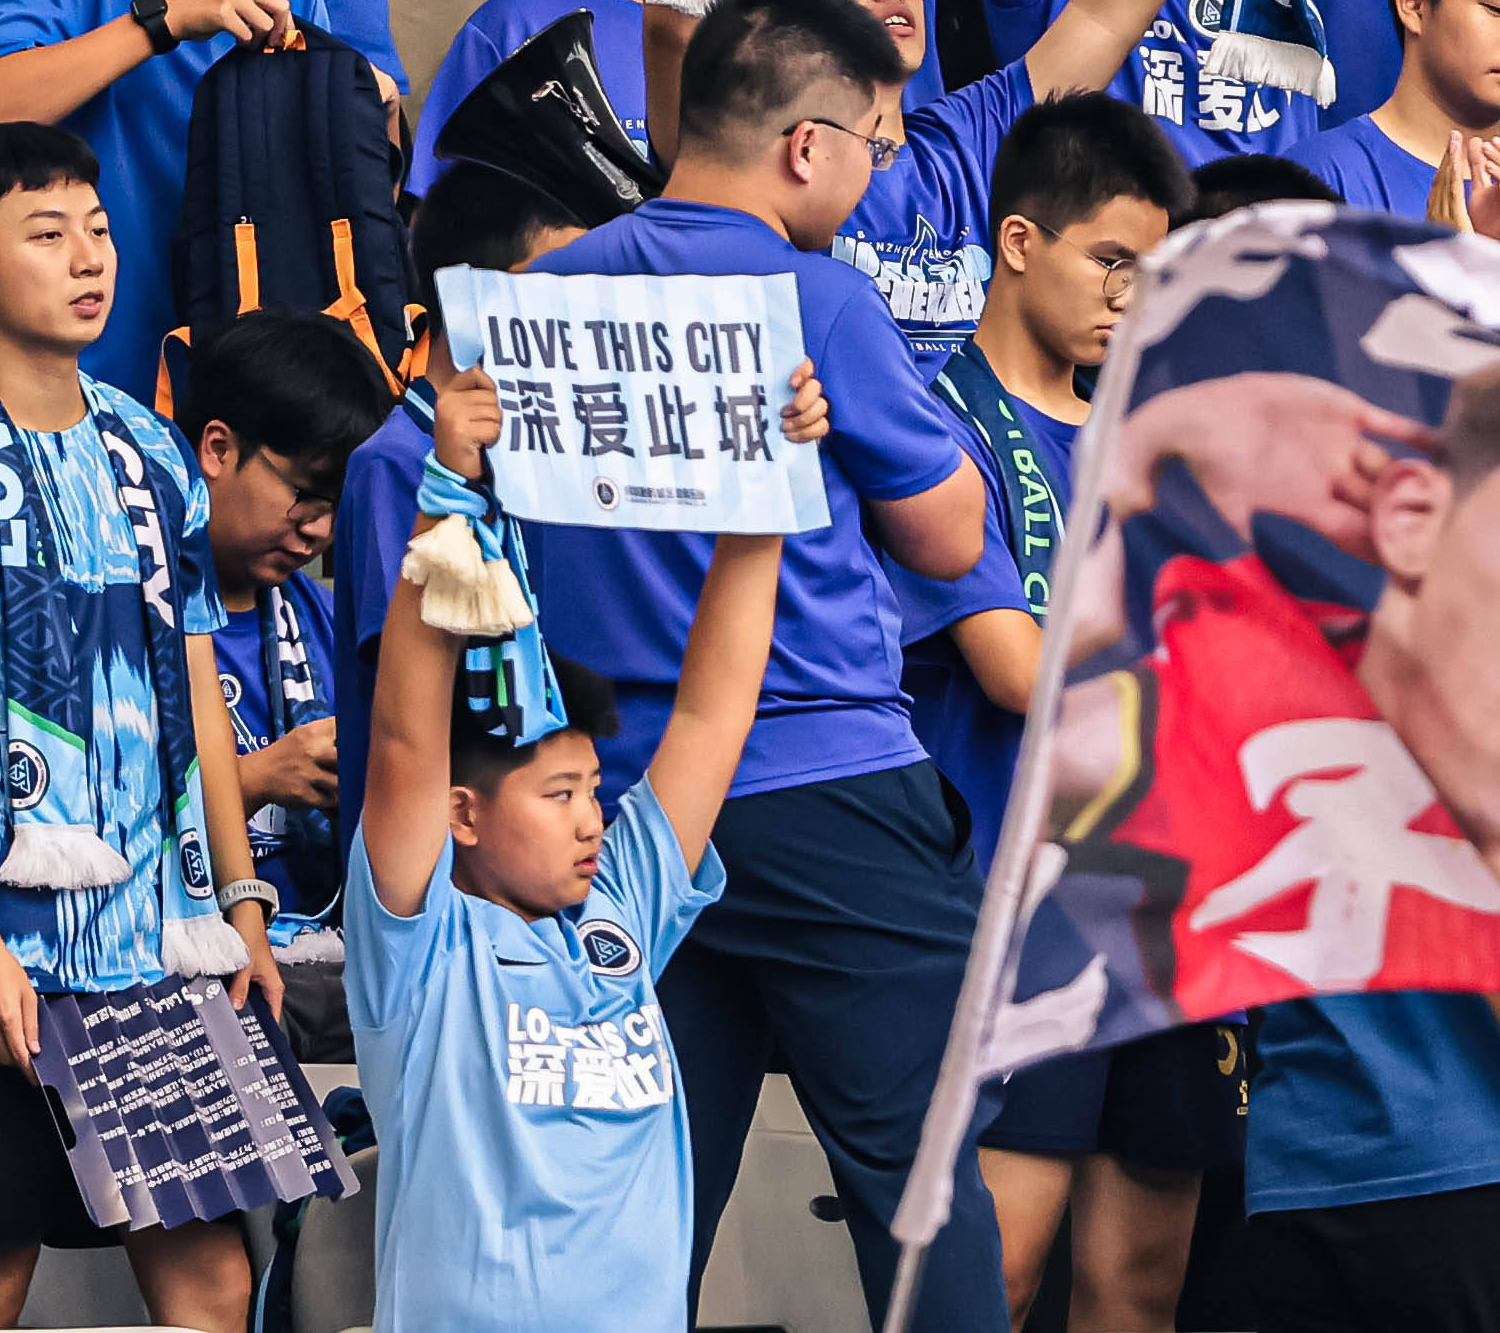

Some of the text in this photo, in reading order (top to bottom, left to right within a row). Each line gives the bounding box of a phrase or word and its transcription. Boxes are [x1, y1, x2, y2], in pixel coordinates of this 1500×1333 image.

[488, 316, 763, 374] LOVE THIS CITY
[498, 379, 774, 462] 深爱此城
[102, 431, 175, 629] CITY
[508, 1043, 672, 1110] 深爱此
